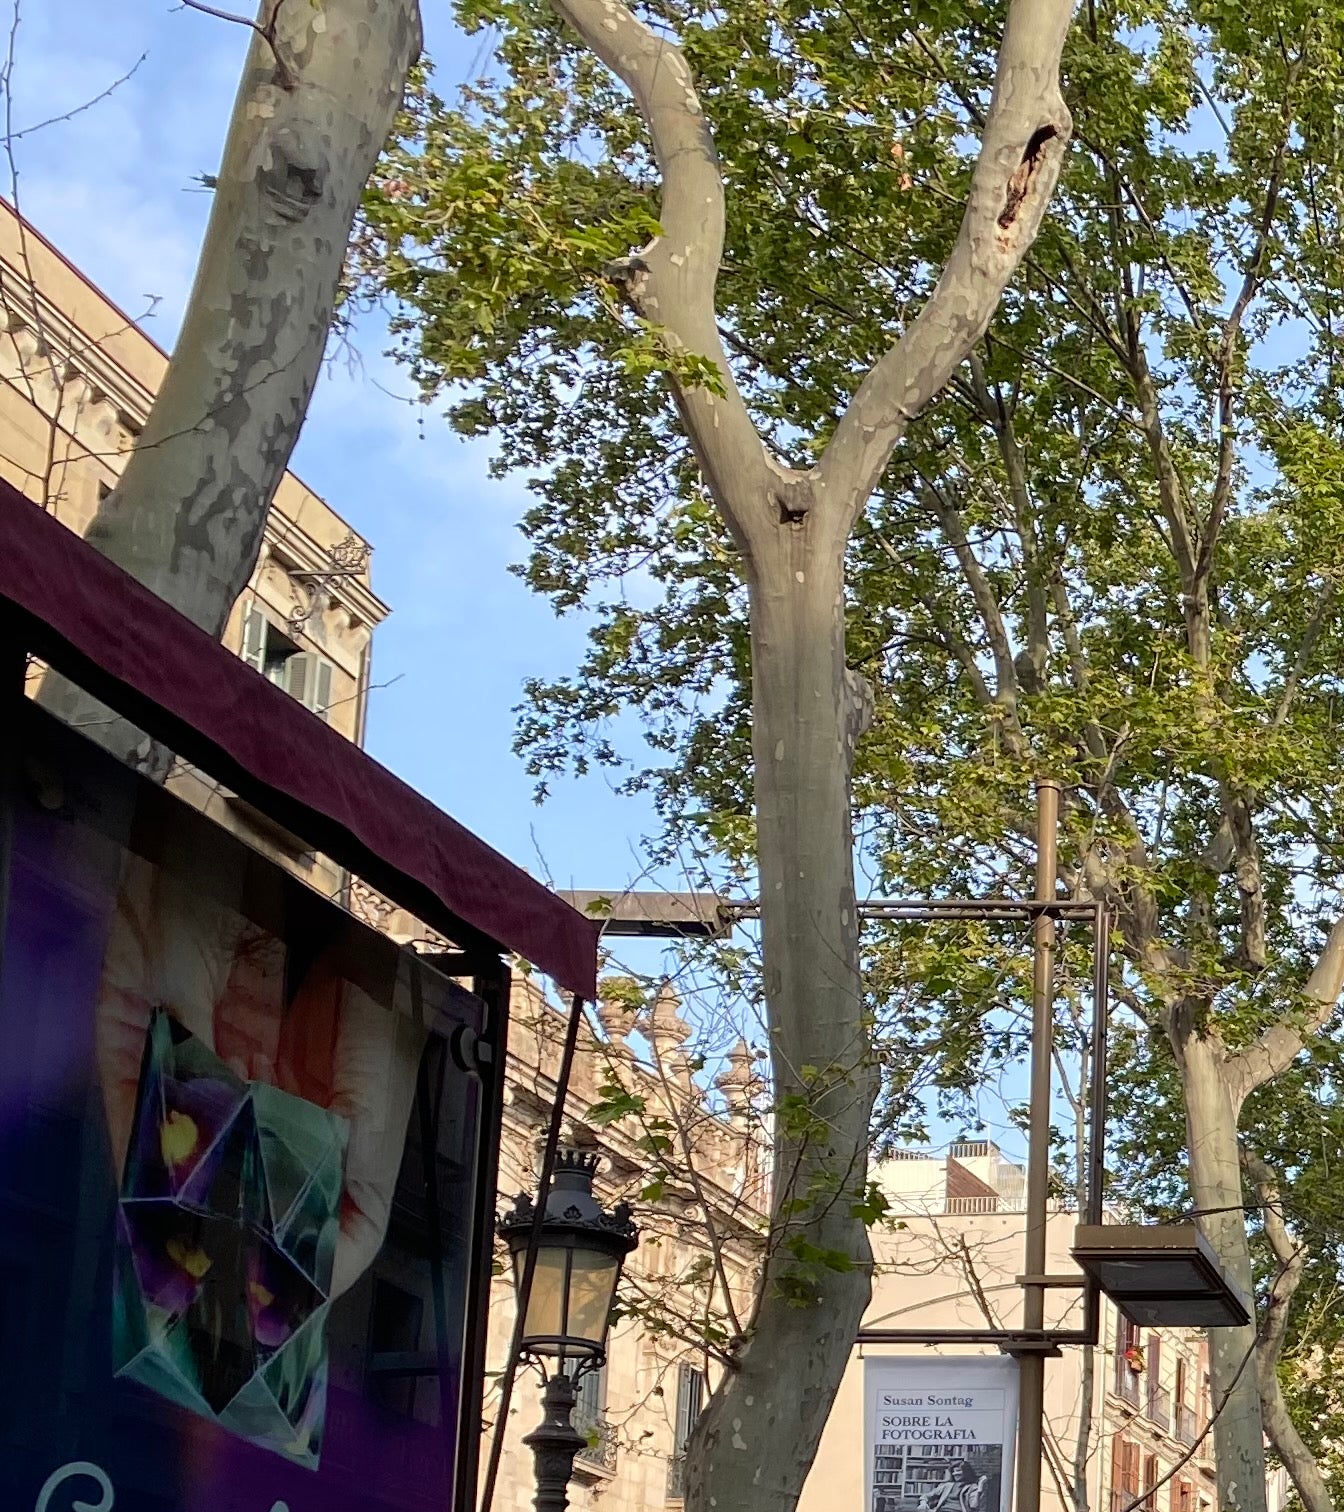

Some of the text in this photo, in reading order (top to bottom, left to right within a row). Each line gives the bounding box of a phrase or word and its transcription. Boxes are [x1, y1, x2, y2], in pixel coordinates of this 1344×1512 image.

[883, 1395, 974, 1408] Susan Sontag
[882, 1416, 954, 1427] SOBRE LA
[882, 1429, 977, 1440] FOTOGRAFIA
